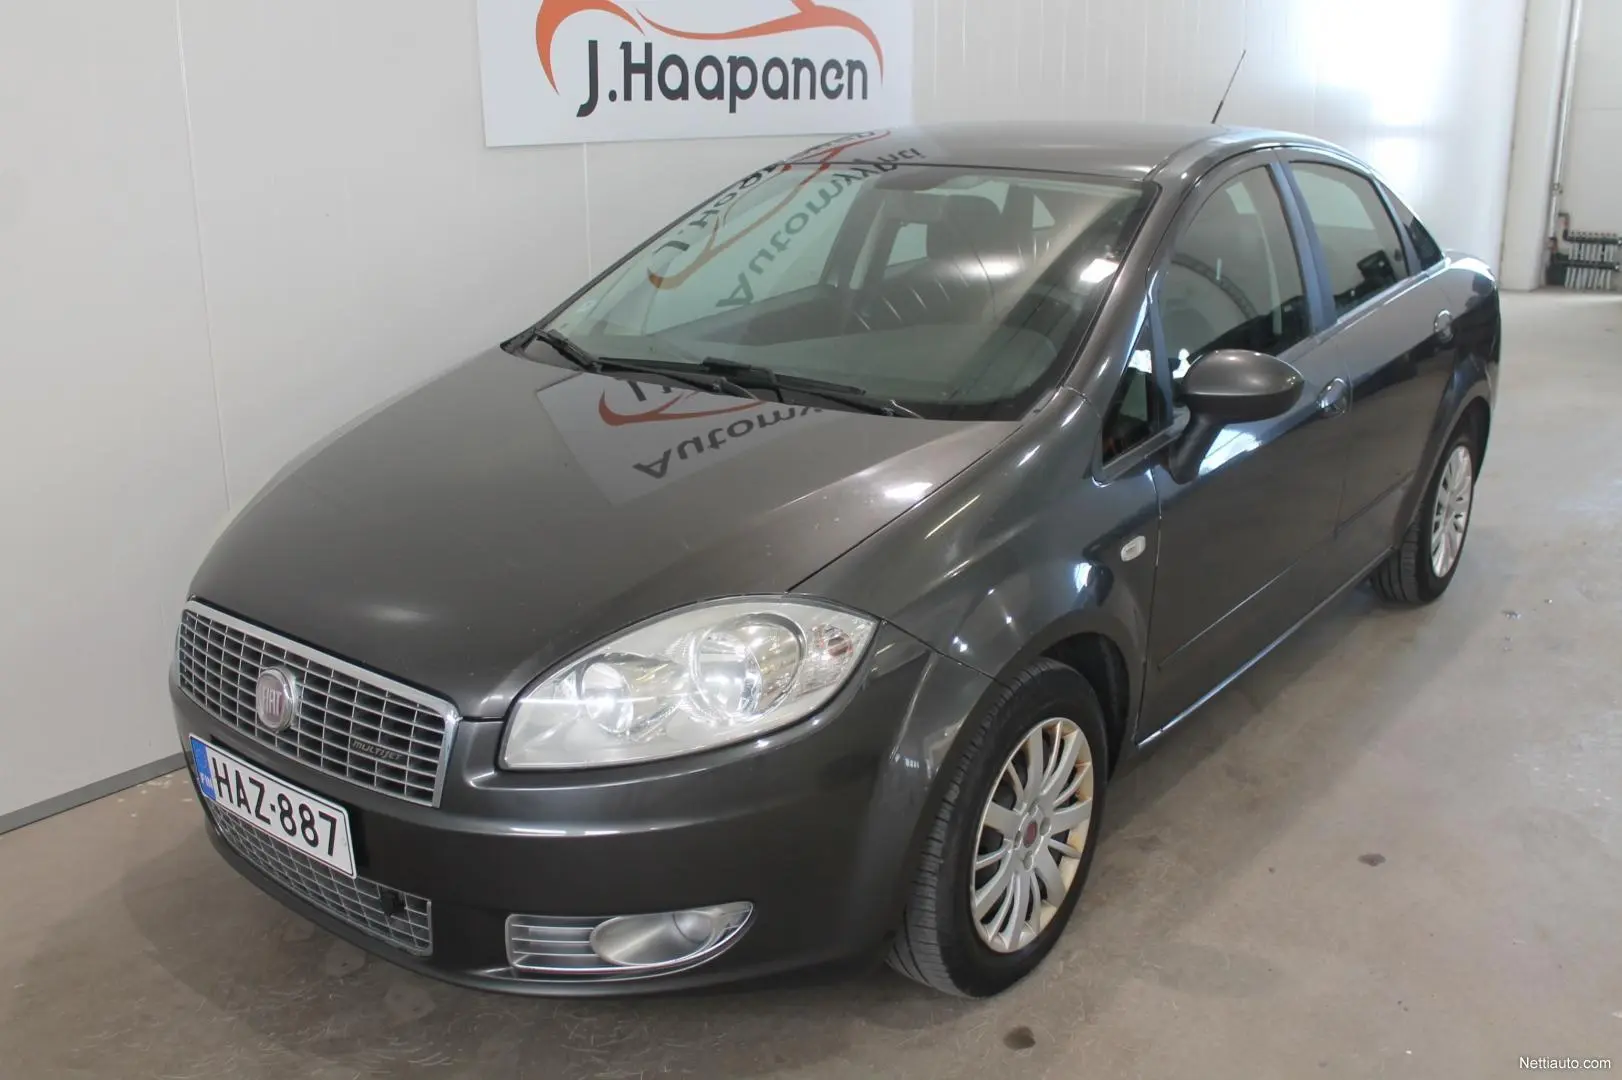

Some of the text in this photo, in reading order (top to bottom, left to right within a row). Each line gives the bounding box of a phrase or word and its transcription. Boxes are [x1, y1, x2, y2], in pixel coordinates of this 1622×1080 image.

[576, 39, 868, 117] J.Haapanen
[264, 687, 282, 717] FIAT
[212, 757, 337, 857] HAZ-887
